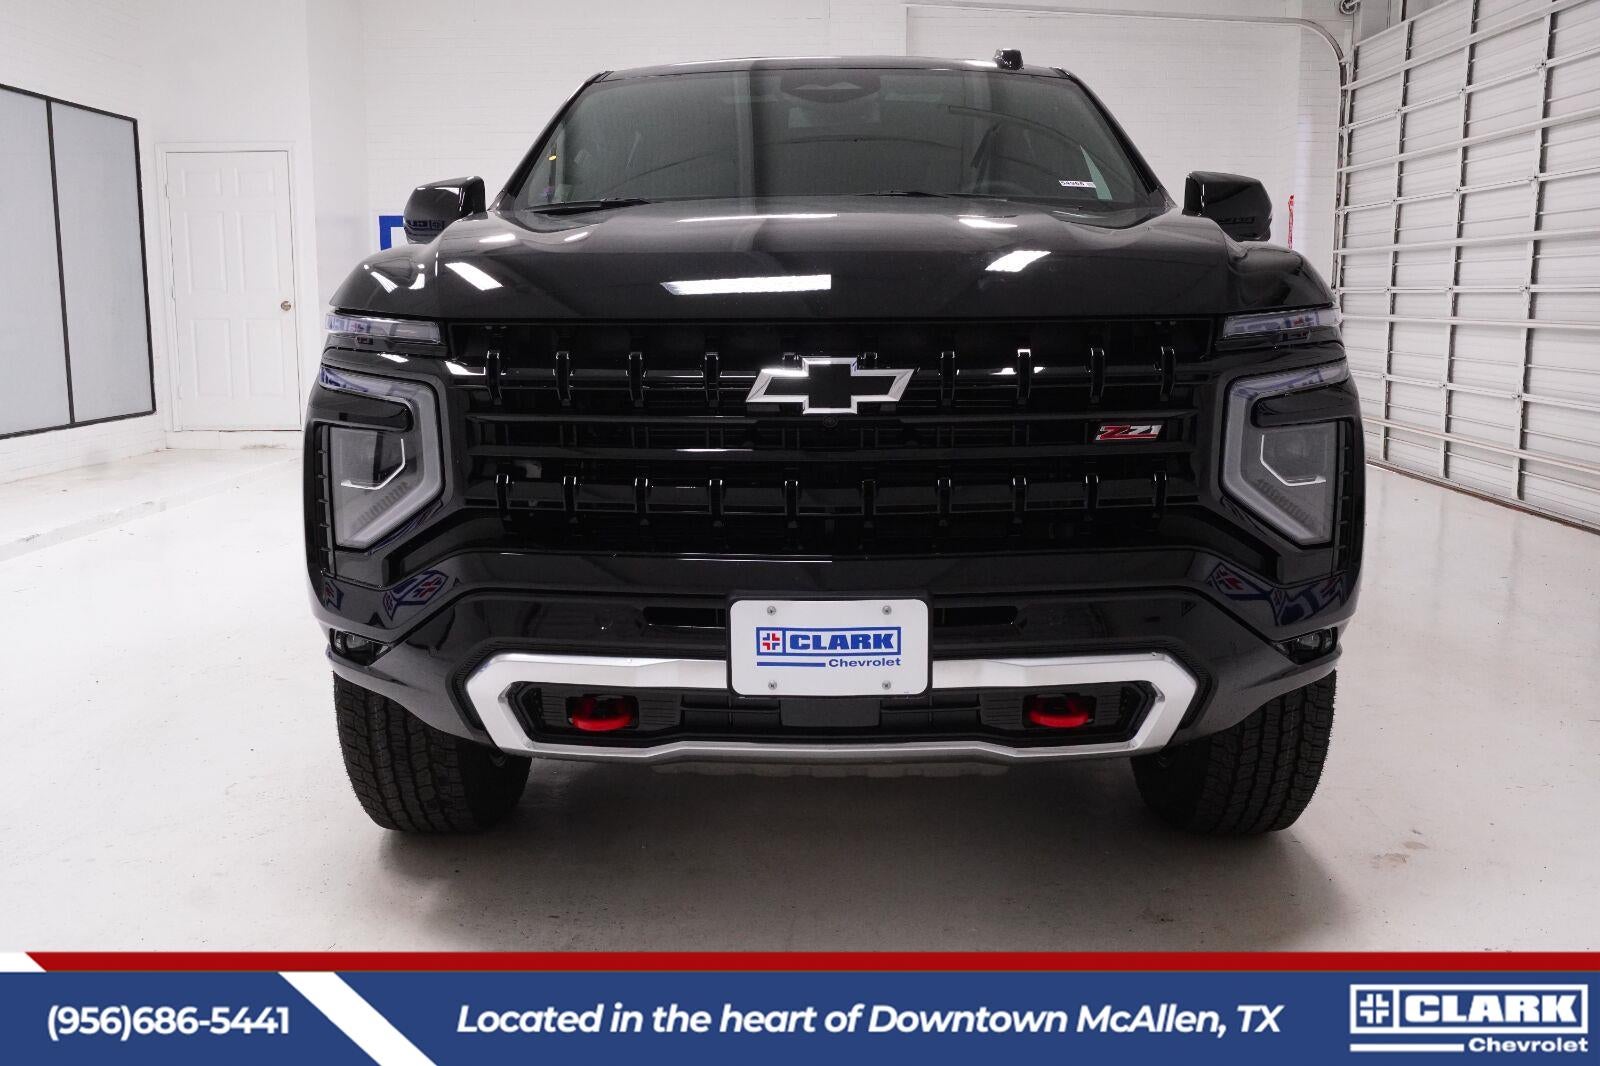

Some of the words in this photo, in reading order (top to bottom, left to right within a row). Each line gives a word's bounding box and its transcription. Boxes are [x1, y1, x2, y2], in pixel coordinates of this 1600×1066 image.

[1096, 424, 1163, 441] Z71
[789, 633, 894, 650] CLARK
[828, 657, 902, 668] Chevrolet
